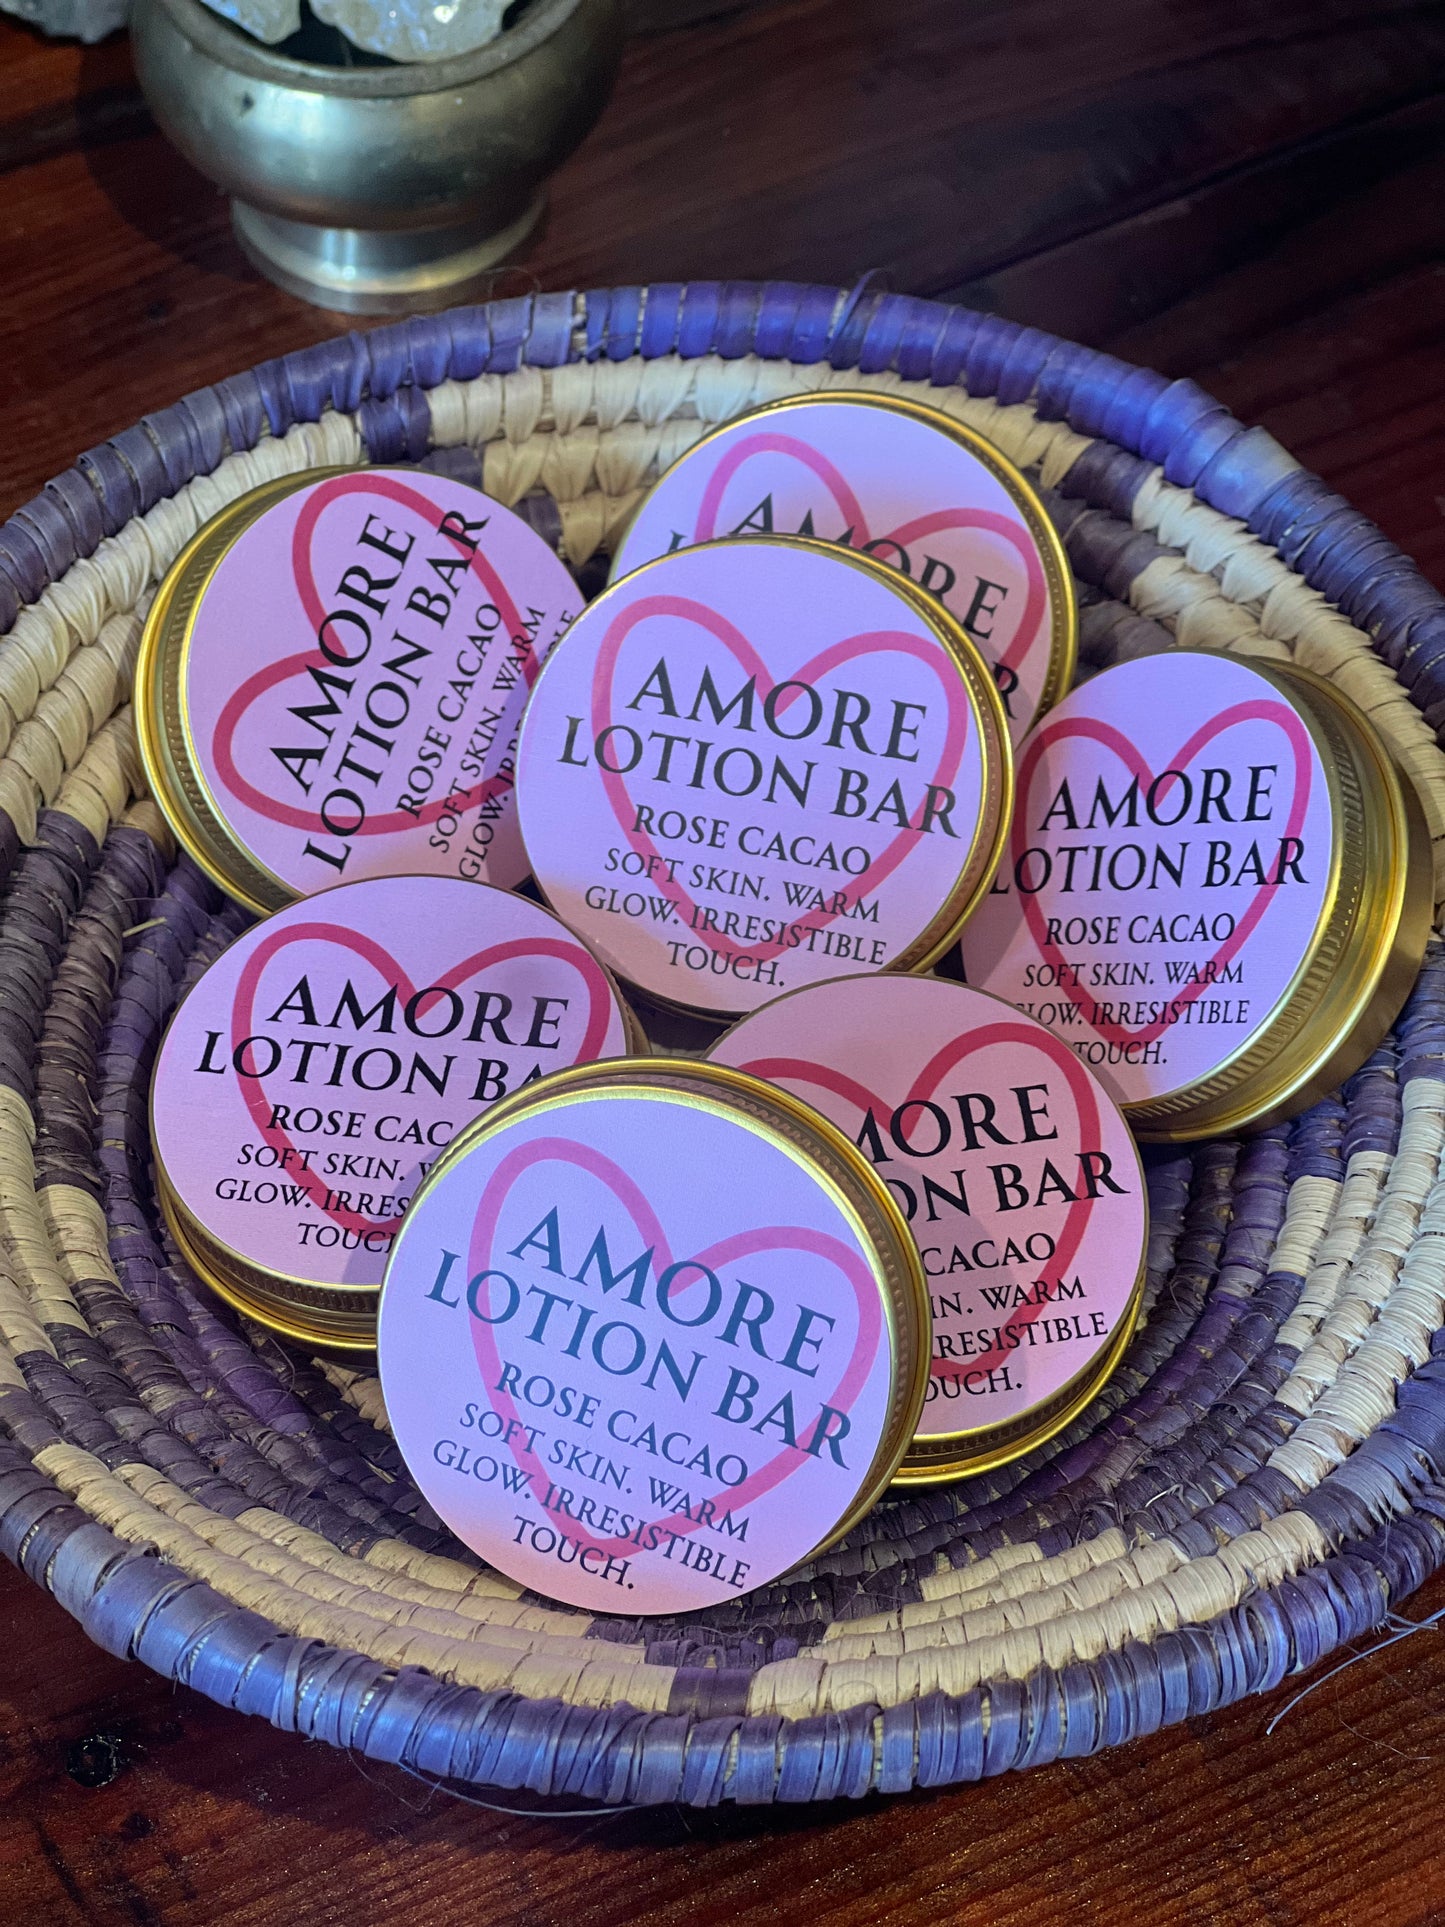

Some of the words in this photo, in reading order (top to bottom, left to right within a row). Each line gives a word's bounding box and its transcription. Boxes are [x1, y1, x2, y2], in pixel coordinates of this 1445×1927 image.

[268, 513, 416, 796] AMORE
[302, 628, 433, 875] LOTION
[404, 509, 491, 630] BAR
[394, 726, 452, 820] ROSE
[437, 603, 502, 723] CACAO
[429, 778, 472, 853] SOFT
[460, 705, 506, 778] SKIN.
[492, 606, 546, 692] WARM
[625, 656, 928, 763] AMORE
[556, 715, 819, 809] LOTION
[829, 767, 962, 839] BAR
[1037, 764, 1278, 832] AMORE
[458, 791, 509, 880] GLOW.
[631, 804, 730, 849] ROSE
[737, 825, 872, 875] CACAO
[1201, 837, 1310, 888] BAR
[604, 848, 685, 883] SOFT
[689, 864, 771, 902] SKIN.
[782, 881, 881, 923] WARM
[584, 885, 680, 925] GLOW.
[689, 905, 888, 966] IRRESISTIBLE
[1043, 916, 1121, 946] ROSE
[1128, 912, 1236, 943] CACAO
[666, 941, 785, 987] TOUCH.
[1023, 962, 1086, 988] SOFT
[1090, 961, 1155, 987] SKIN.
[1164, 960, 1245, 985] WARM
[265, 974, 569, 1050] AMORE
[1090, 999, 1250, 1026] IRRESISTIBLE
[193, 1030, 459, 1099] LOTION
[236, 1144, 319, 1173] SOFT
[322, 1152, 405, 1182] SKIN.
[265, 1104, 366, 1139] ROSE
[374, 1115, 454, 1147] CAC
[214, 1178, 312, 1209] GLOW.
[986, 1150, 1132, 1213] BAR
[505, 1205, 837, 1378] AMORE
[919, 1232, 1056, 1277] CACAO
[979, 1275, 1088, 1310] WARM
[424, 1248, 708, 1403] LOTION
[711, 1365, 853, 1471] BAR
[925, 1366, 1023, 1403] OUCH.
[494, 1360, 602, 1429] ROSE
[606, 1409, 749, 1487] CACAO
[459, 1402, 546, 1455] SOFT
[547, 1438, 633, 1495] SKIN.
[648, 1475, 751, 1543] WARM
[432, 1439, 531, 1501] GLOW.
[540, 1481, 752, 1589] IRRESISTIBLE
[512, 1515, 635, 1591] TOUCH.
